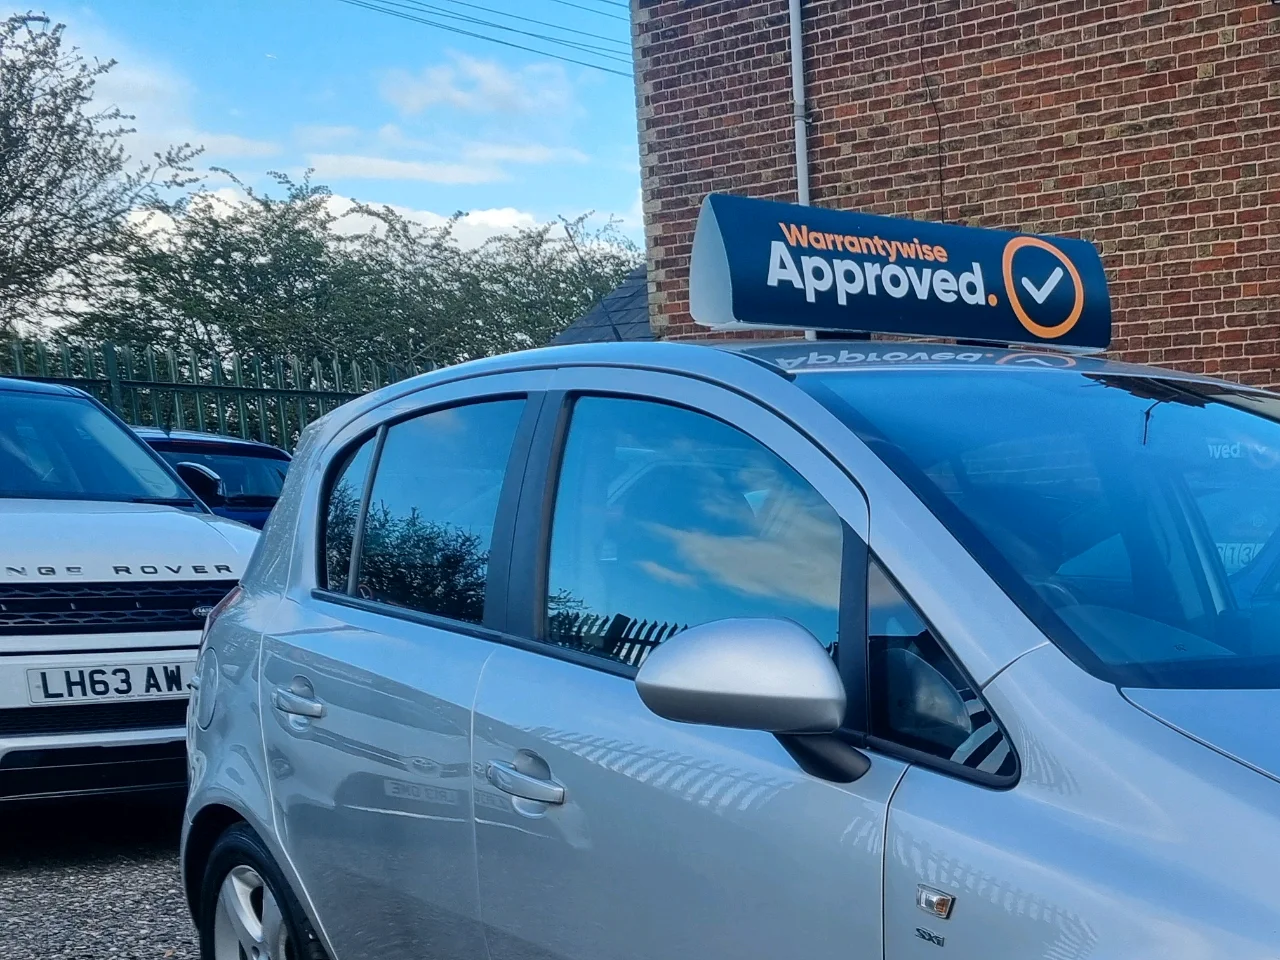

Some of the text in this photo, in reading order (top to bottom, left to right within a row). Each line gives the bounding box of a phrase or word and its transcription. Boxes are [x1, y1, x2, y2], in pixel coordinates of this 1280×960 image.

[778, 222, 948, 263] Warrantywise
[766, 240, 998, 307] Approved.
[5, 564, 233, 576] NGE ROVER
[40, 665, 190, 699] LH63 AW
